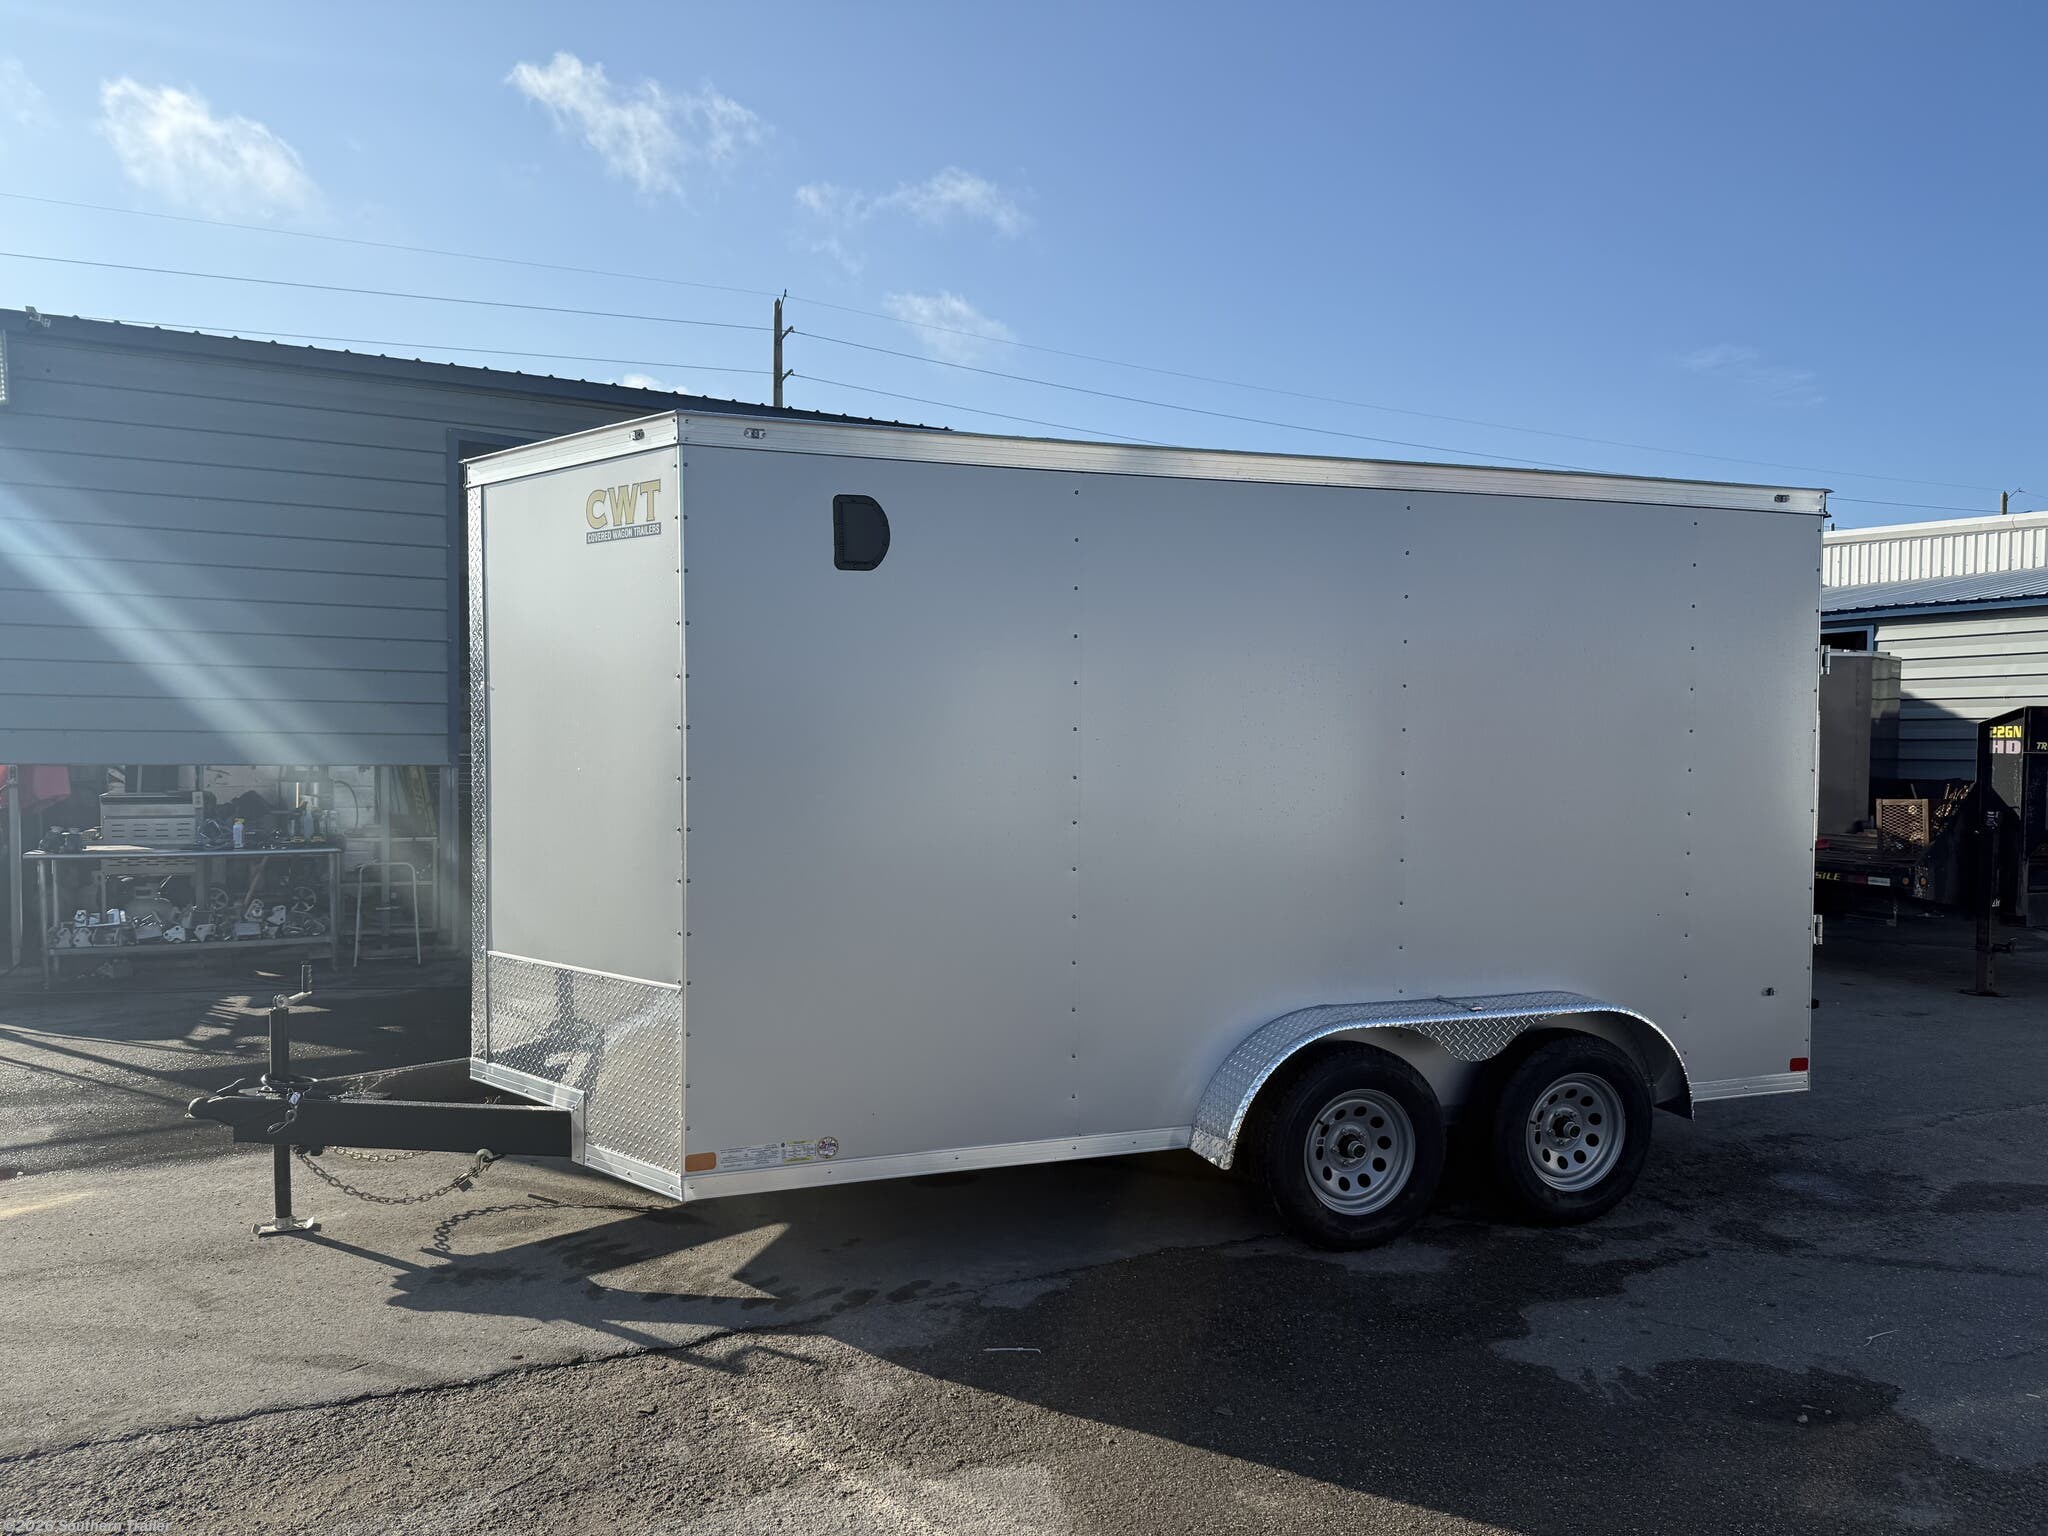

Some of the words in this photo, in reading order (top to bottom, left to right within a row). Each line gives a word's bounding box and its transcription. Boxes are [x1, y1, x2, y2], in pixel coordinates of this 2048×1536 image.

[586, 479, 661, 529] CWT
[588, 531, 611, 543] COVERED
[612, 527, 632, 539] WAGON
[633, 524, 660, 536] TRAILERS
[1989, 740, 2022, 754] HD
